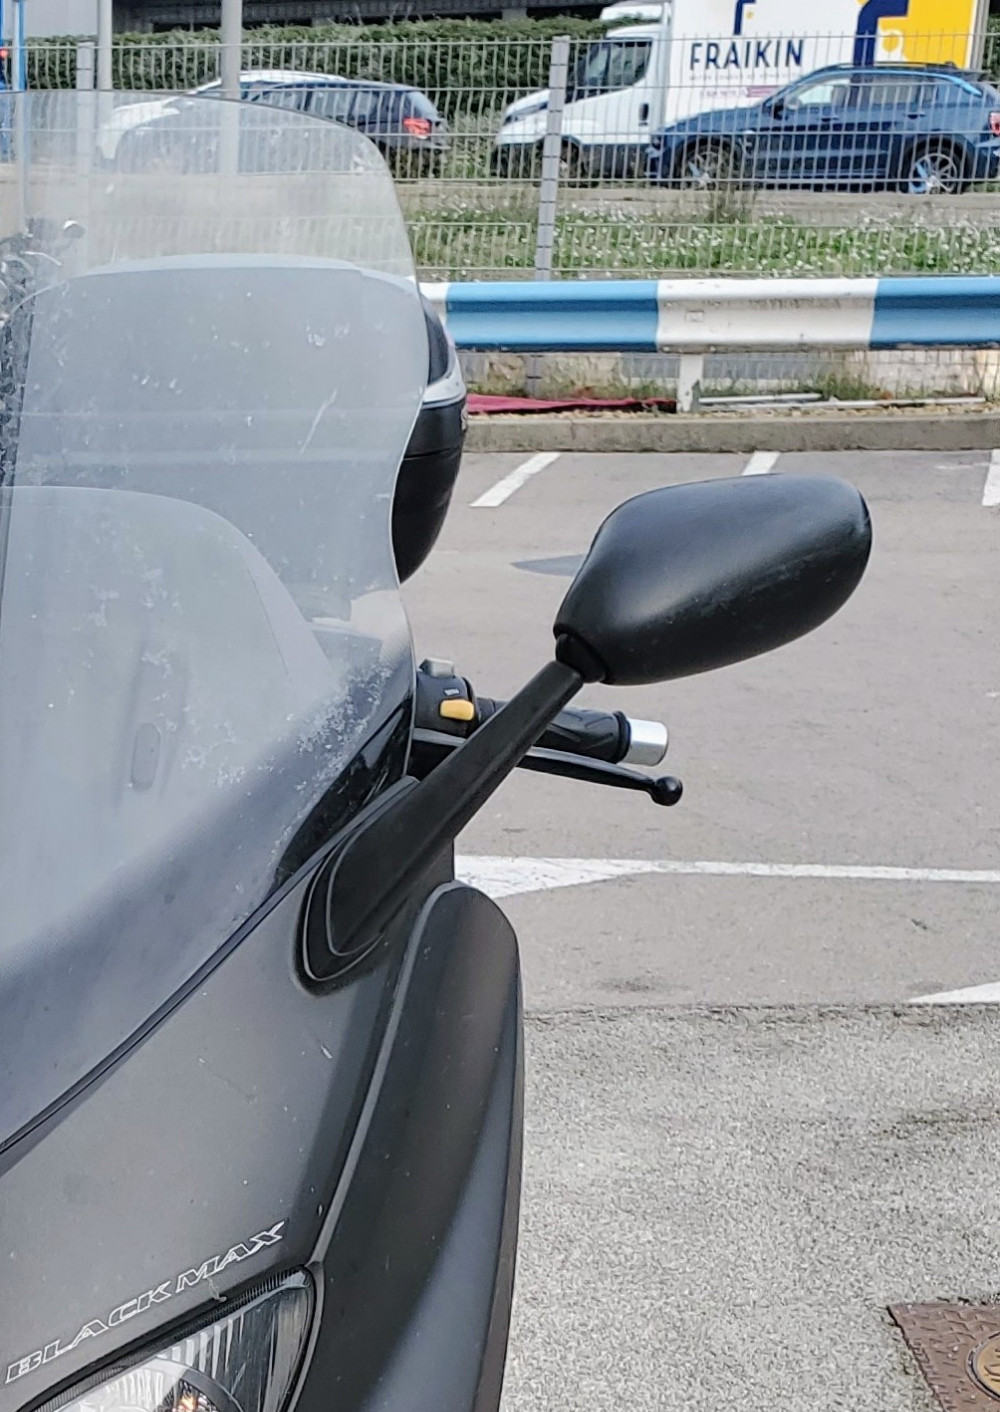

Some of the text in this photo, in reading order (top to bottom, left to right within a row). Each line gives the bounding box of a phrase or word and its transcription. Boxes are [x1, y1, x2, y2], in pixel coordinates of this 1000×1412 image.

[690, 39, 804, 70] FRAIKIN
[5, 1220, 285, 1384] BLACK MAX
